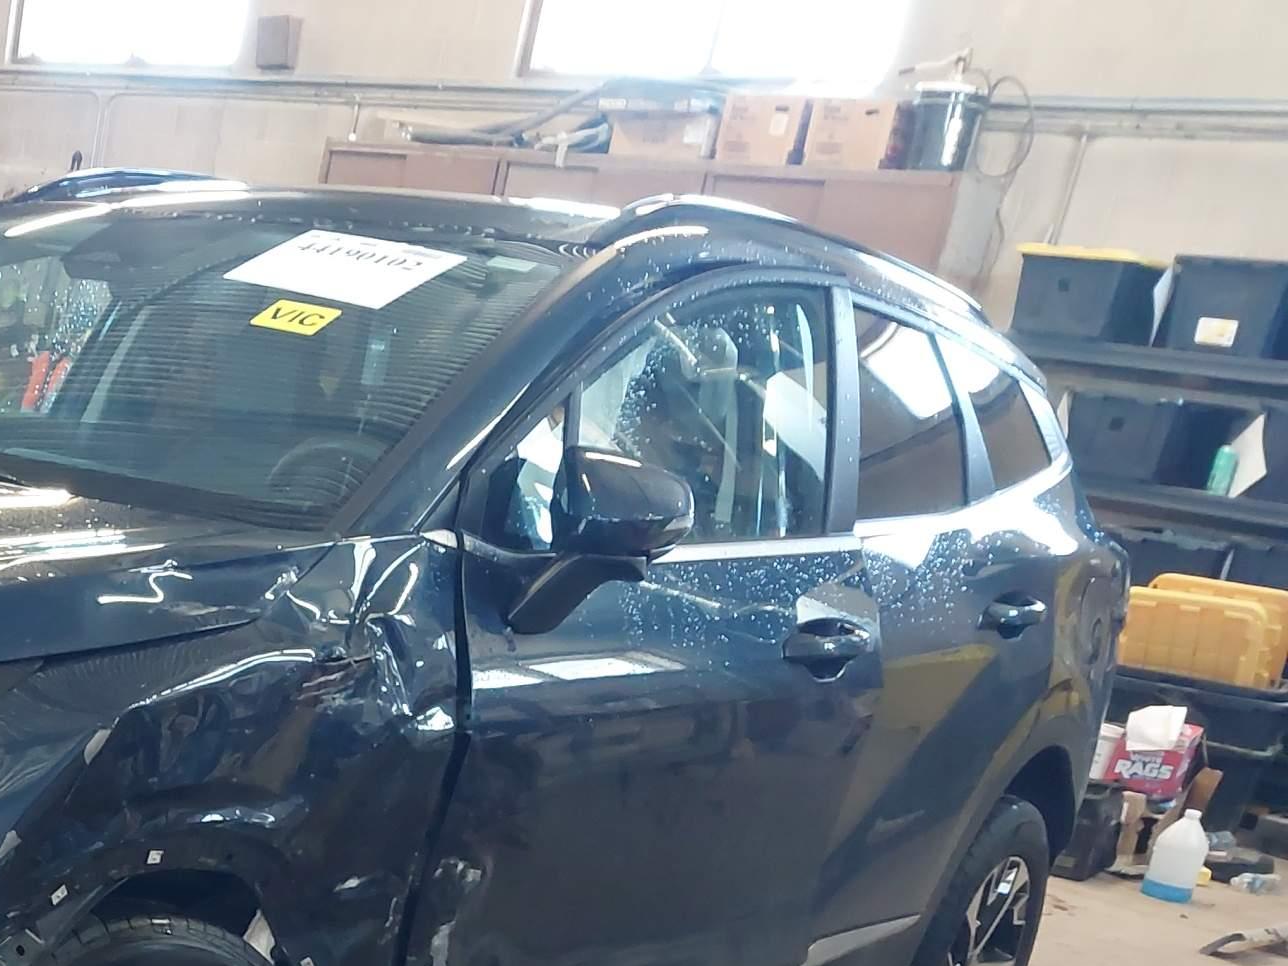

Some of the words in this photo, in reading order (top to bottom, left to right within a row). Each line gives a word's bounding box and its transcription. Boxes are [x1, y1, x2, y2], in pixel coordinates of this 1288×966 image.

[297, 241, 424, 271] 44190102
[271, 306, 326, 328] VIC
[1113, 758, 1175, 780] RAGS
